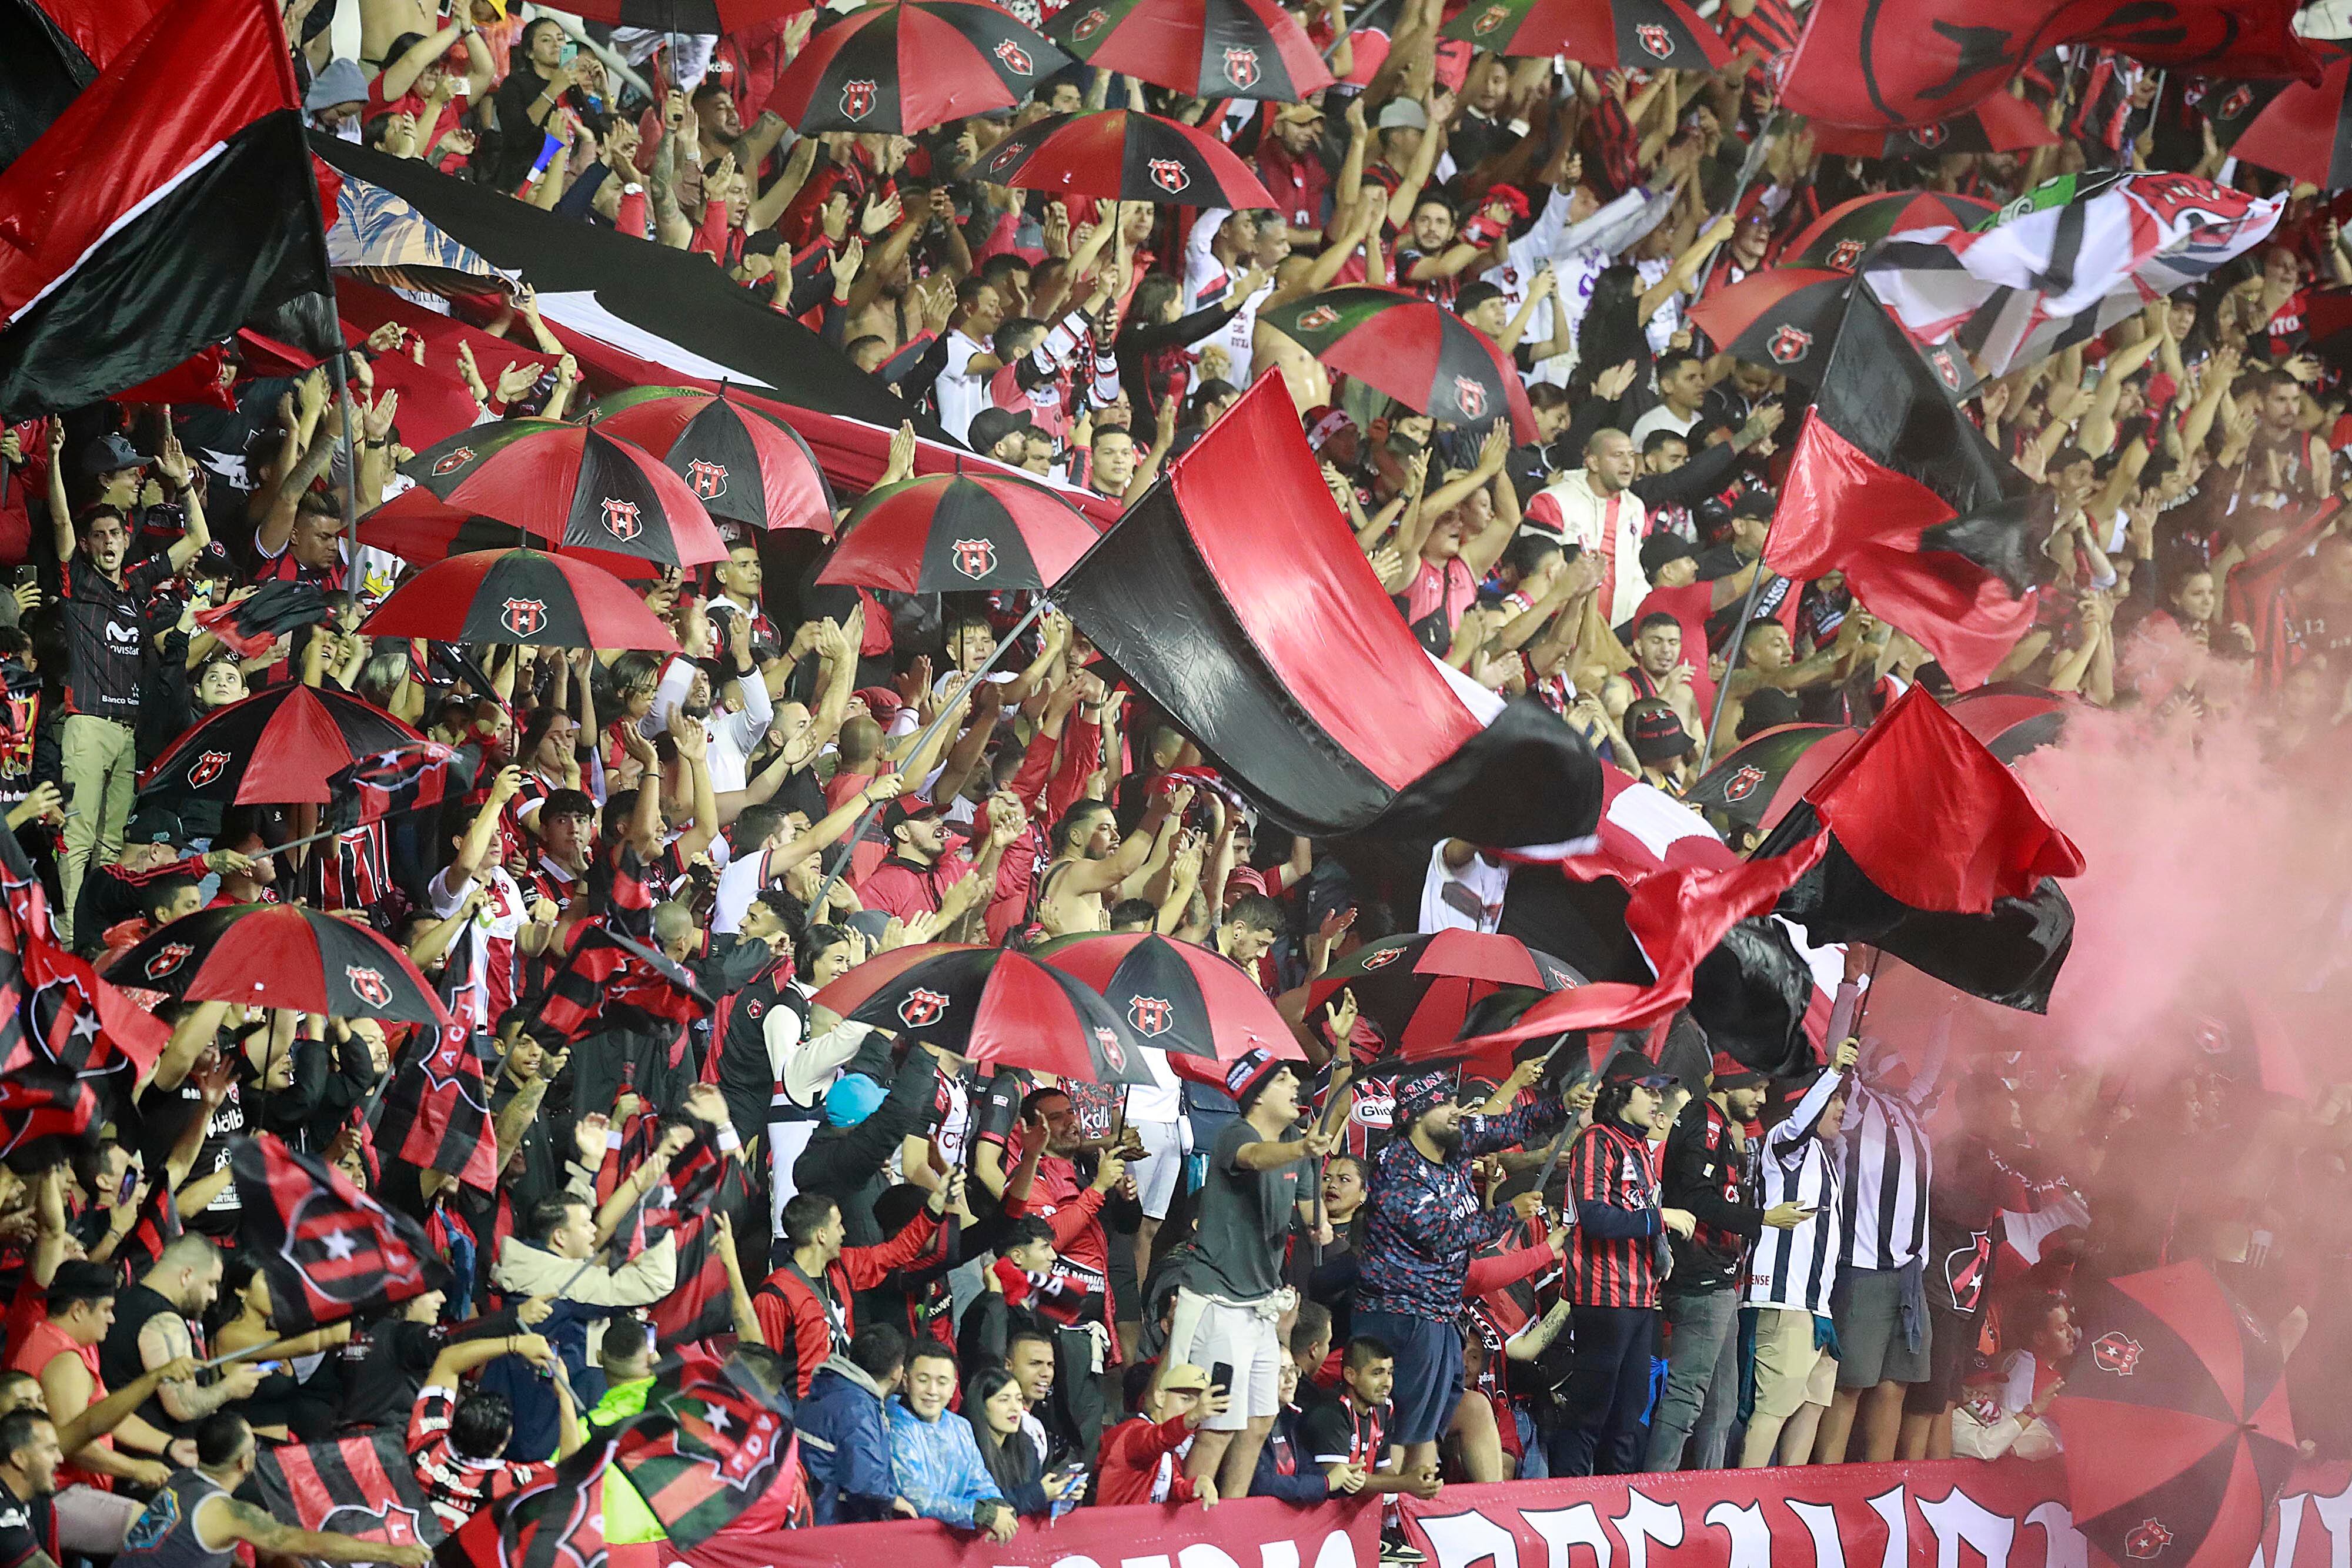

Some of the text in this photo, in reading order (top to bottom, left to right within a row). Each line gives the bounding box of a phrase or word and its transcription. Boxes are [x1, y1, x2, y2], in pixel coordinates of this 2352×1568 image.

[696, 465, 718, 475] LDA
[610, 504, 633, 514] LDA
[102, 695, 125, 704] Banco
[918, 994, 940, 1004] LDA
[1140, 1001, 1163, 1009] LDA
[441, 1005, 473, 1067] LDA
[2148, 1525, 2165, 1541] LDA
